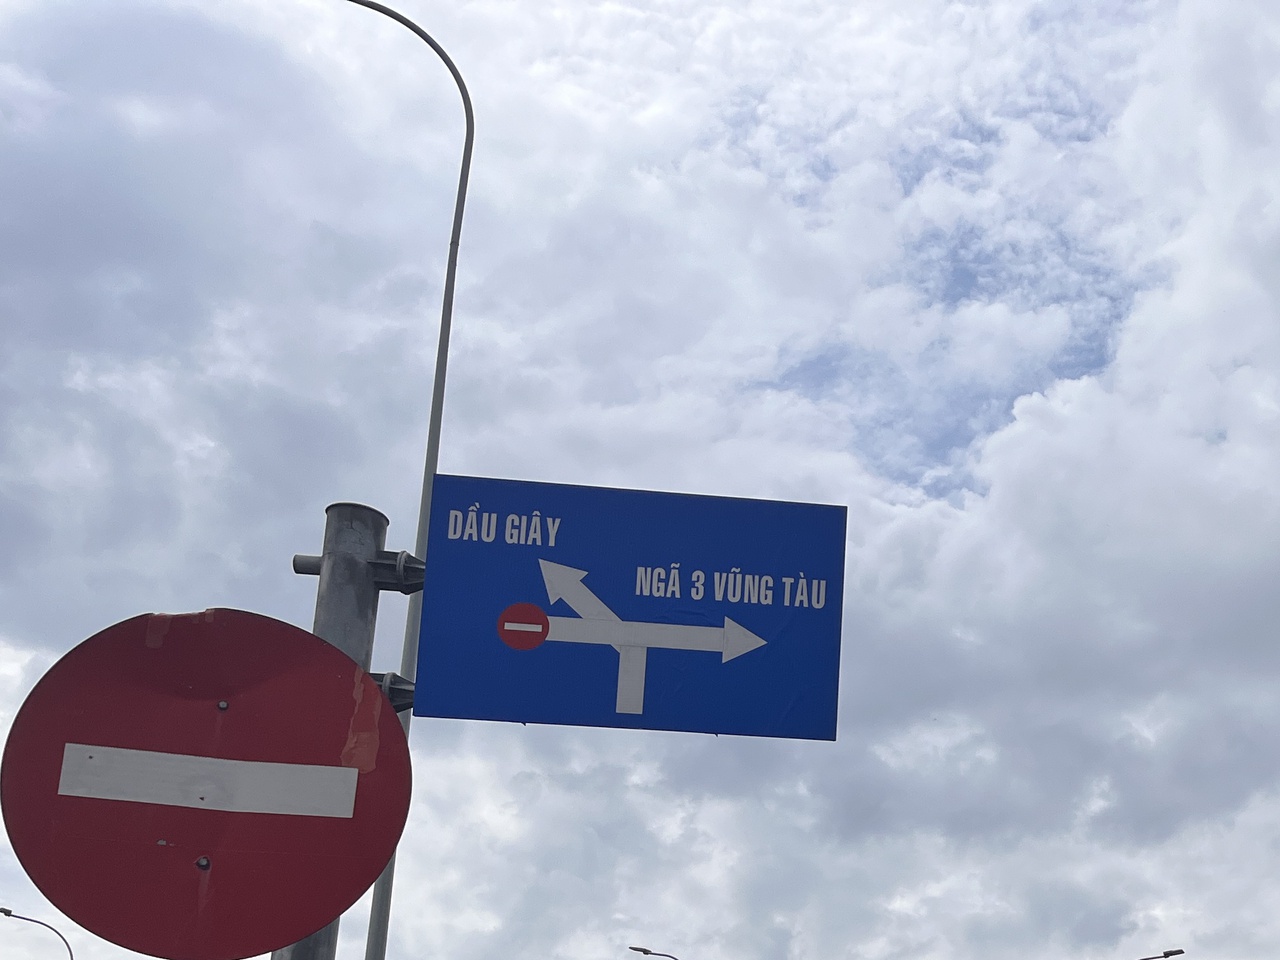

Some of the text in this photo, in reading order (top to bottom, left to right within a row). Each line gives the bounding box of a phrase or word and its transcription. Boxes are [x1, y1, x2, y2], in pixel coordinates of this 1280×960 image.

[448, 502, 562, 547] DẦU GIÂY
[635, 562, 827, 609] NGÃ 3 VŨNG TÀU
